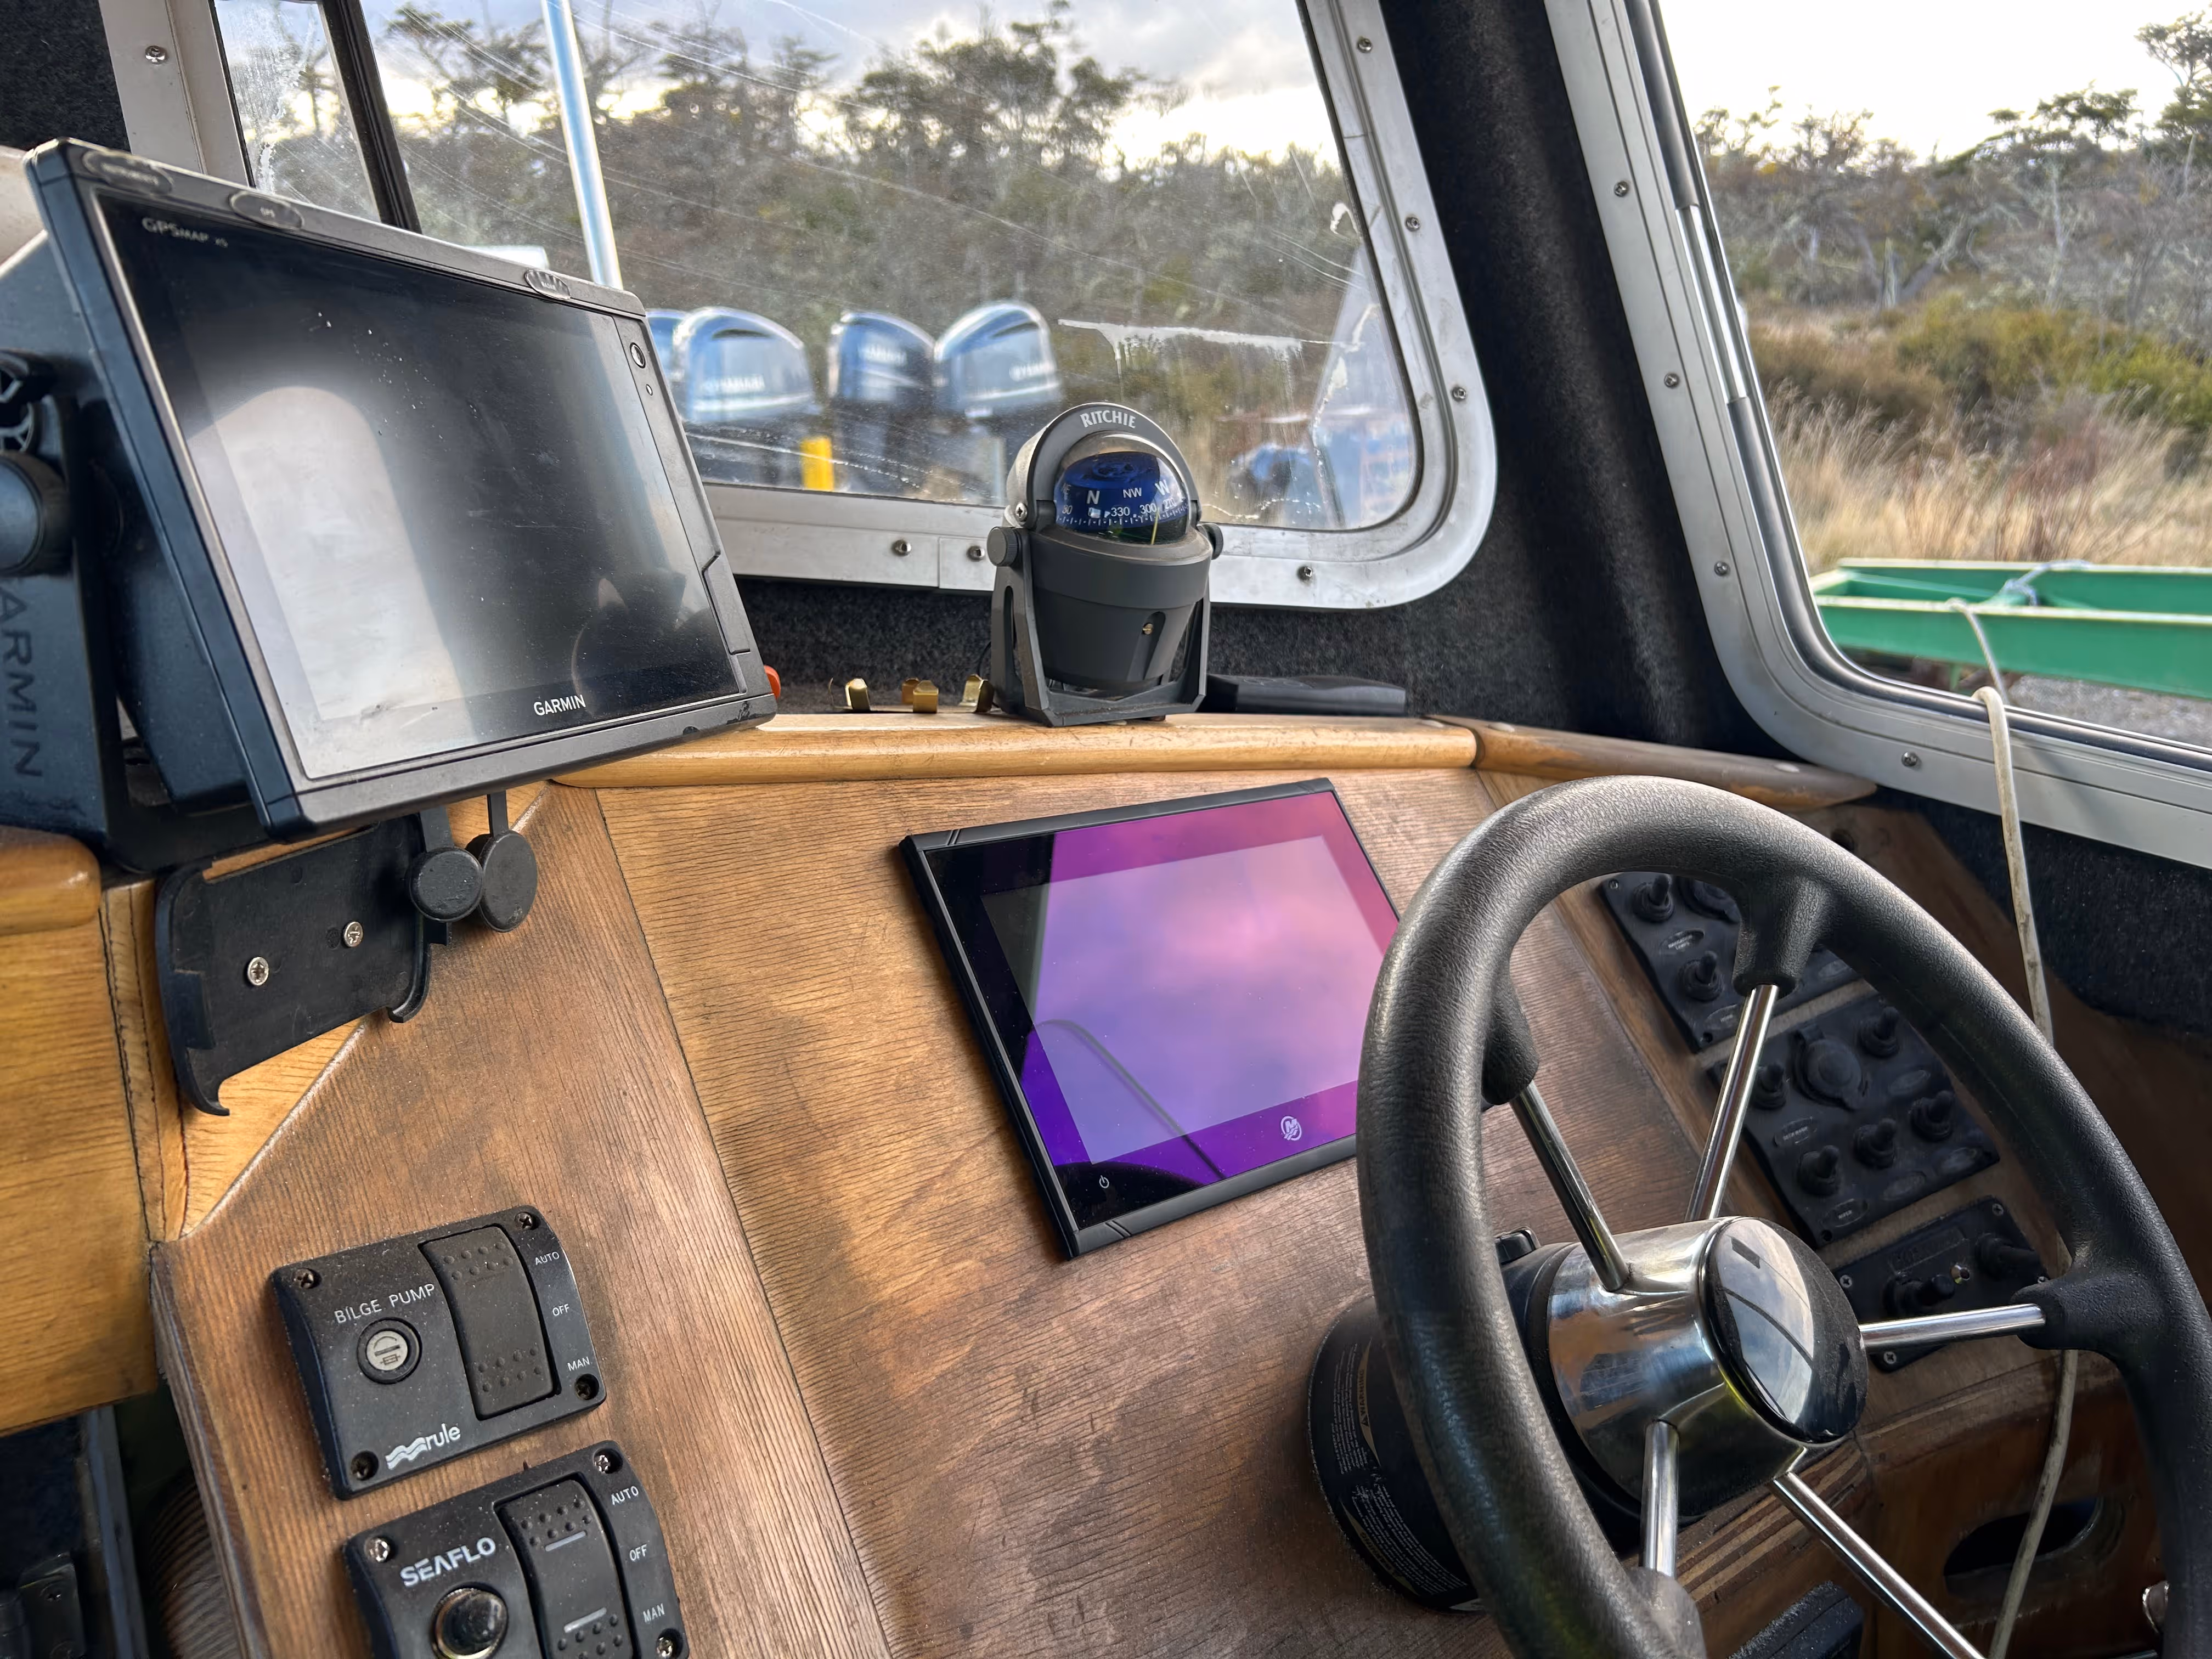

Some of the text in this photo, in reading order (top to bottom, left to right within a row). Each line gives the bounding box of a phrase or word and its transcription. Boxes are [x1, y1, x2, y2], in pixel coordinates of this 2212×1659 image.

[1079, 410, 1136, 429] RITCHIE
[1086, 490, 1101, 505] N
[1122, 487, 1142, 498] NW
[1154, 479, 1170, 496] W
[1110, 506, 1131, 517] 330
[1139, 503, 1156, 515] 300
[0, 586, 43, 777] ARMIN
[533, 694, 586, 716] GARMIN
[535, 1250, 560, 1265] AUTO
[335, 1284, 435, 1324] BILGE PUMP
[552, 1303, 570, 1317] OFF
[567, 1356, 590, 1371] MAN
[425, 1424, 461, 1453] rule
[611, 1486, 640, 1506] AUTO
[400, 1537, 496, 1587] SEAFLO
[629, 1544, 648, 1562] OFF
[643, 1603, 665, 1622] MAN
